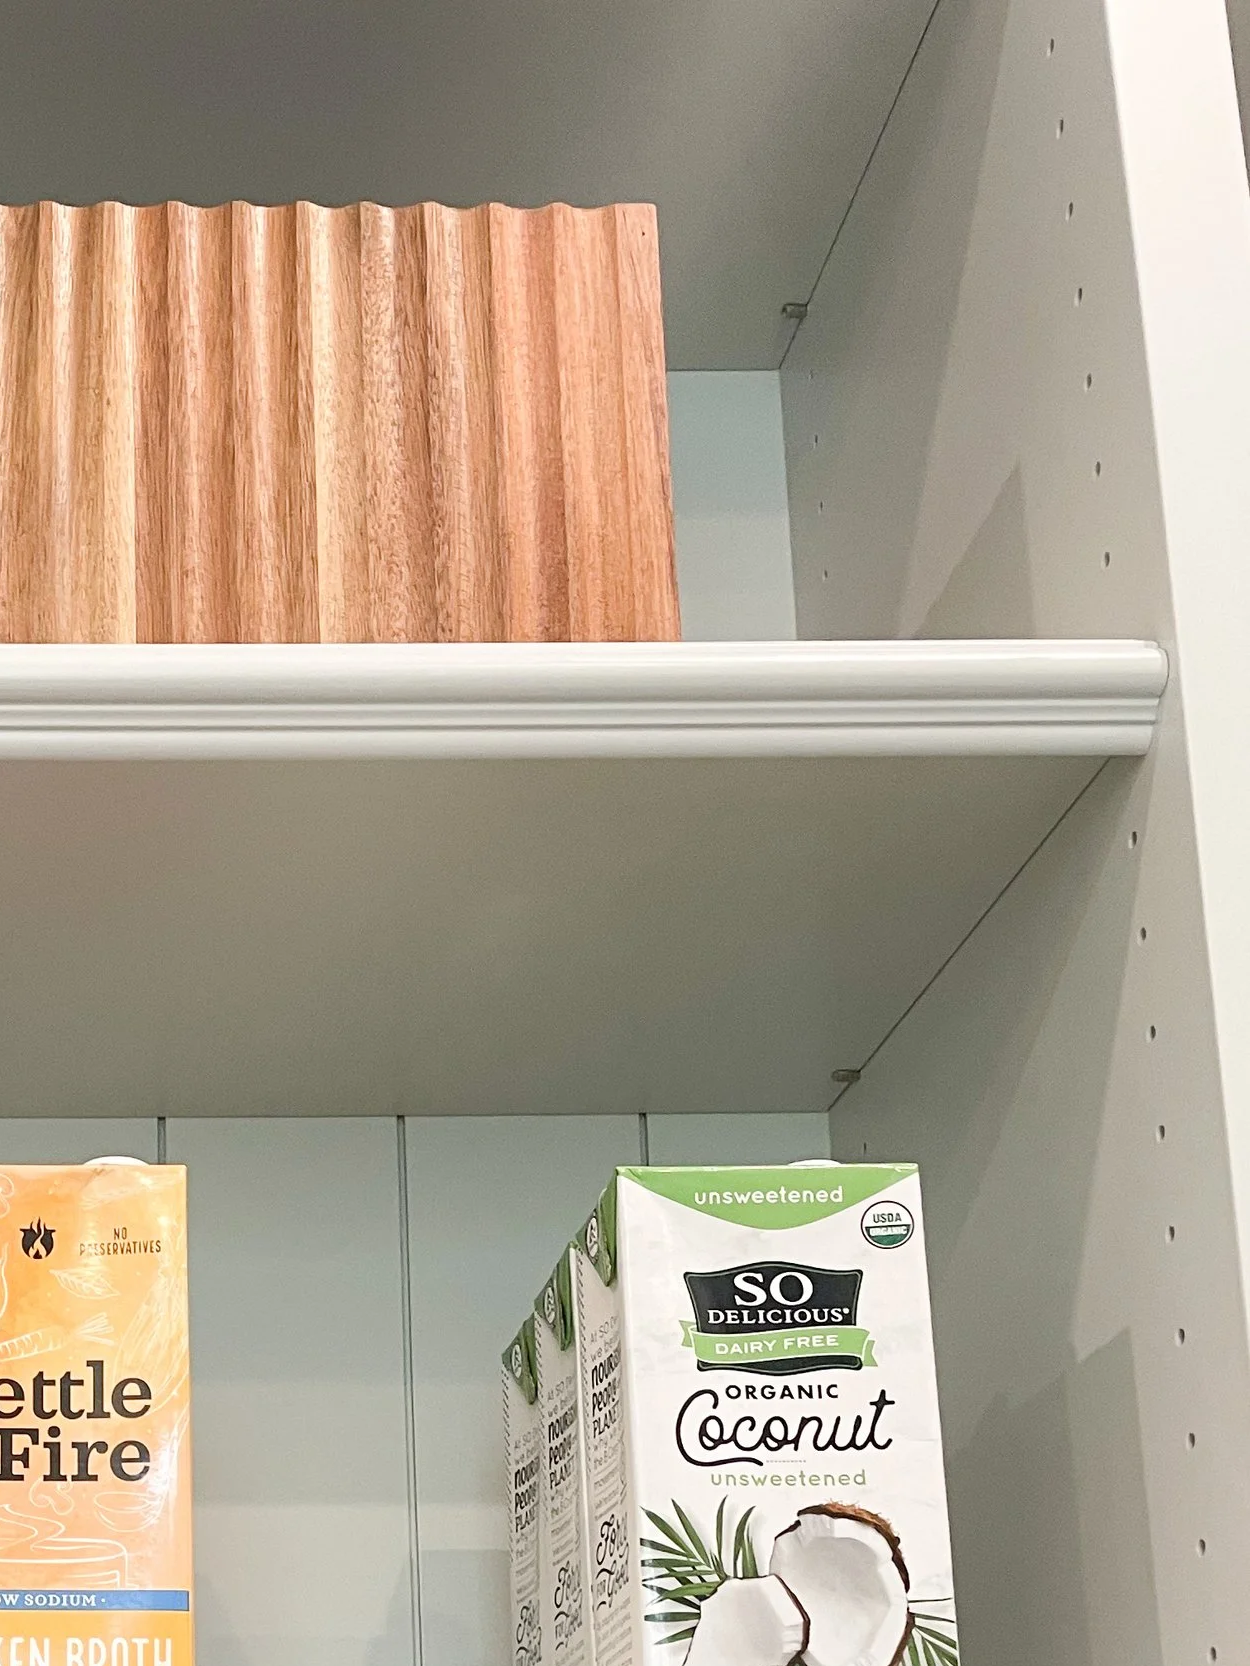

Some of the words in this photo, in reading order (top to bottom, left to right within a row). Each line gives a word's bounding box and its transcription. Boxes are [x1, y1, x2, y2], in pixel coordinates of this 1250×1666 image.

[694, 1186, 844, 1205] unsweetened
[872, 1213, 902, 1223] USDA
[113, 1227, 128, 1240] NO
[733, 1272, 813, 1306] SO
[707, 1309, 843, 1324] DELICIOUS
[715, 1339, 774, 1355] DAIRY
[783, 1334, 839, 1349] FREE
[725, 1384, 839, 1399] ORGANIC
[676, 1389, 896, 1467] Coconut
[710, 1470, 867, 1487] unsweetened
[24, 1594, 97, 1607] SODIUM
